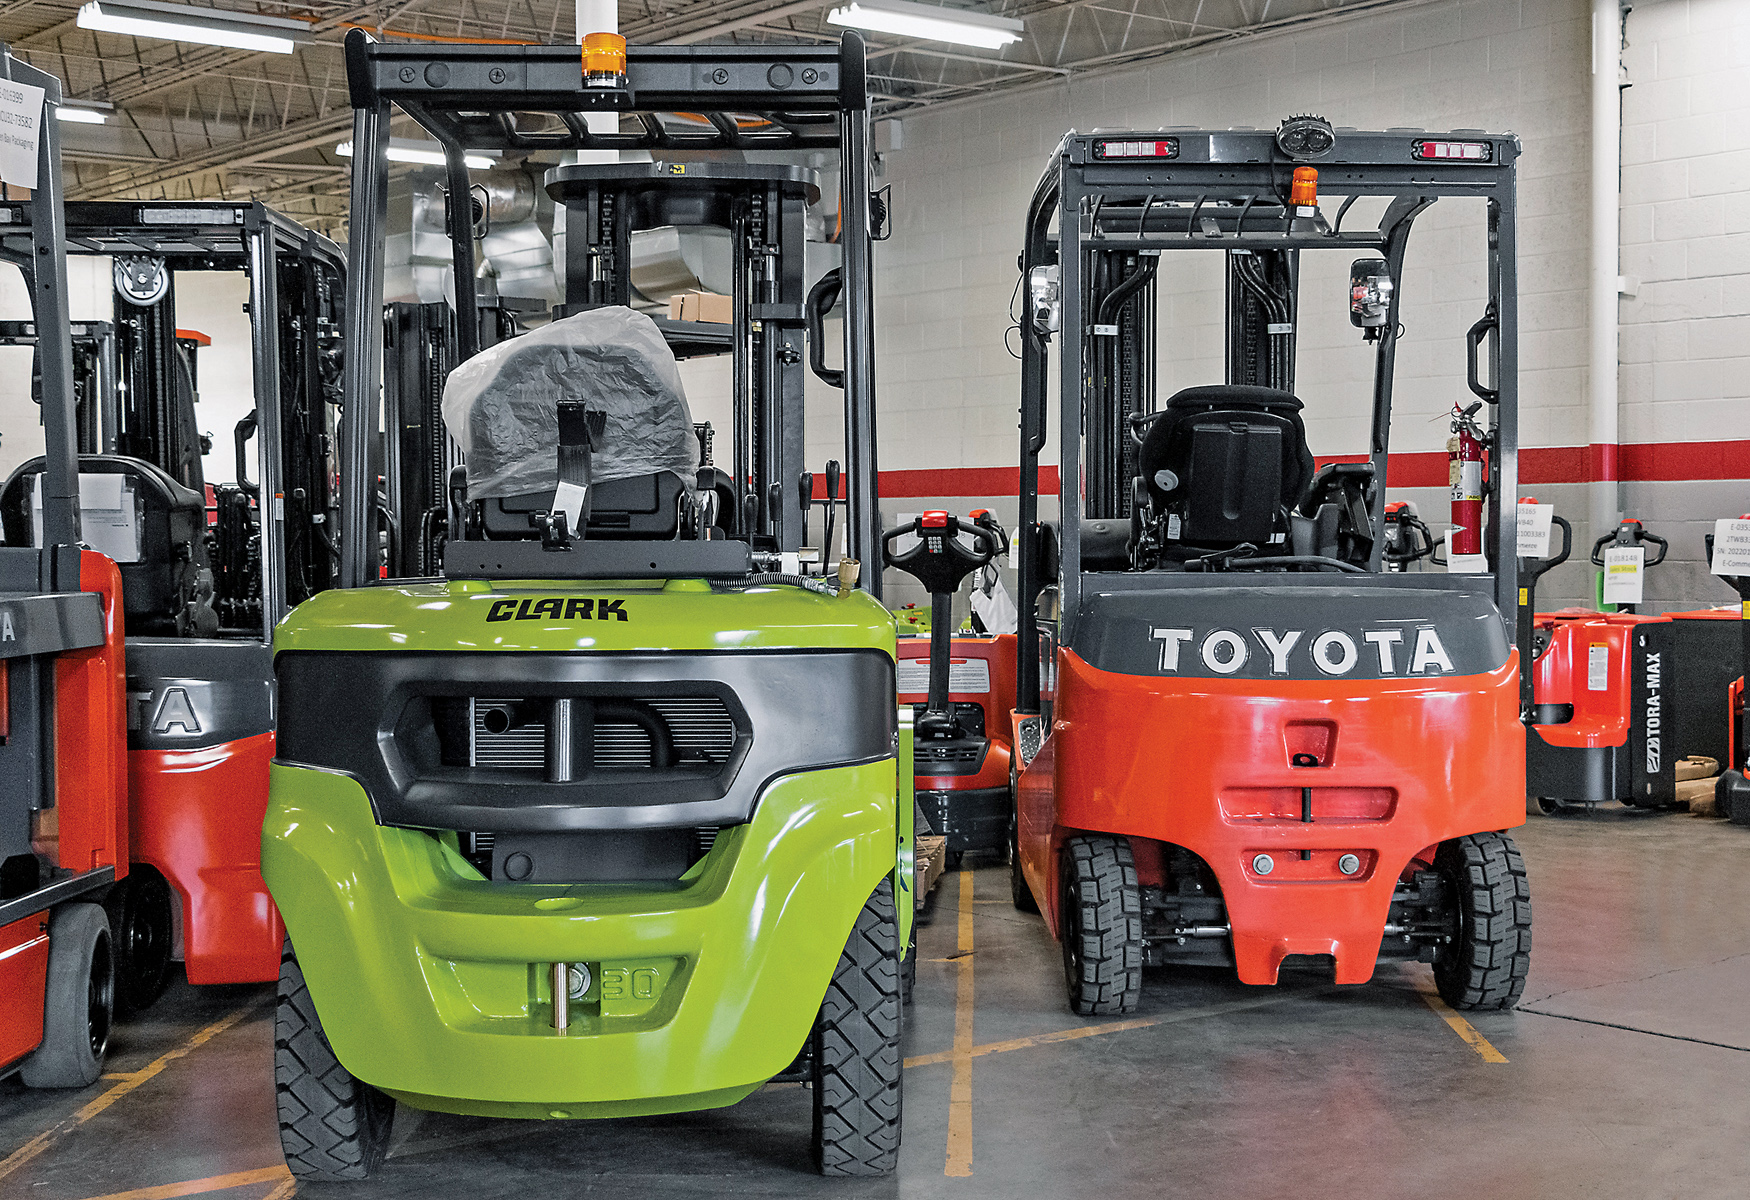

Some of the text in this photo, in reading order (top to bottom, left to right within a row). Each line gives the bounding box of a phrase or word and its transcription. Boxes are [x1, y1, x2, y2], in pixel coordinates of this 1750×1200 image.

[486, 598, 629, 622] CLARK
[1150, 625, 1456, 675] TOYOTA
[1647, 653, 1660, 737] TORA-MAX
[602, 967, 660, 1000] 30
